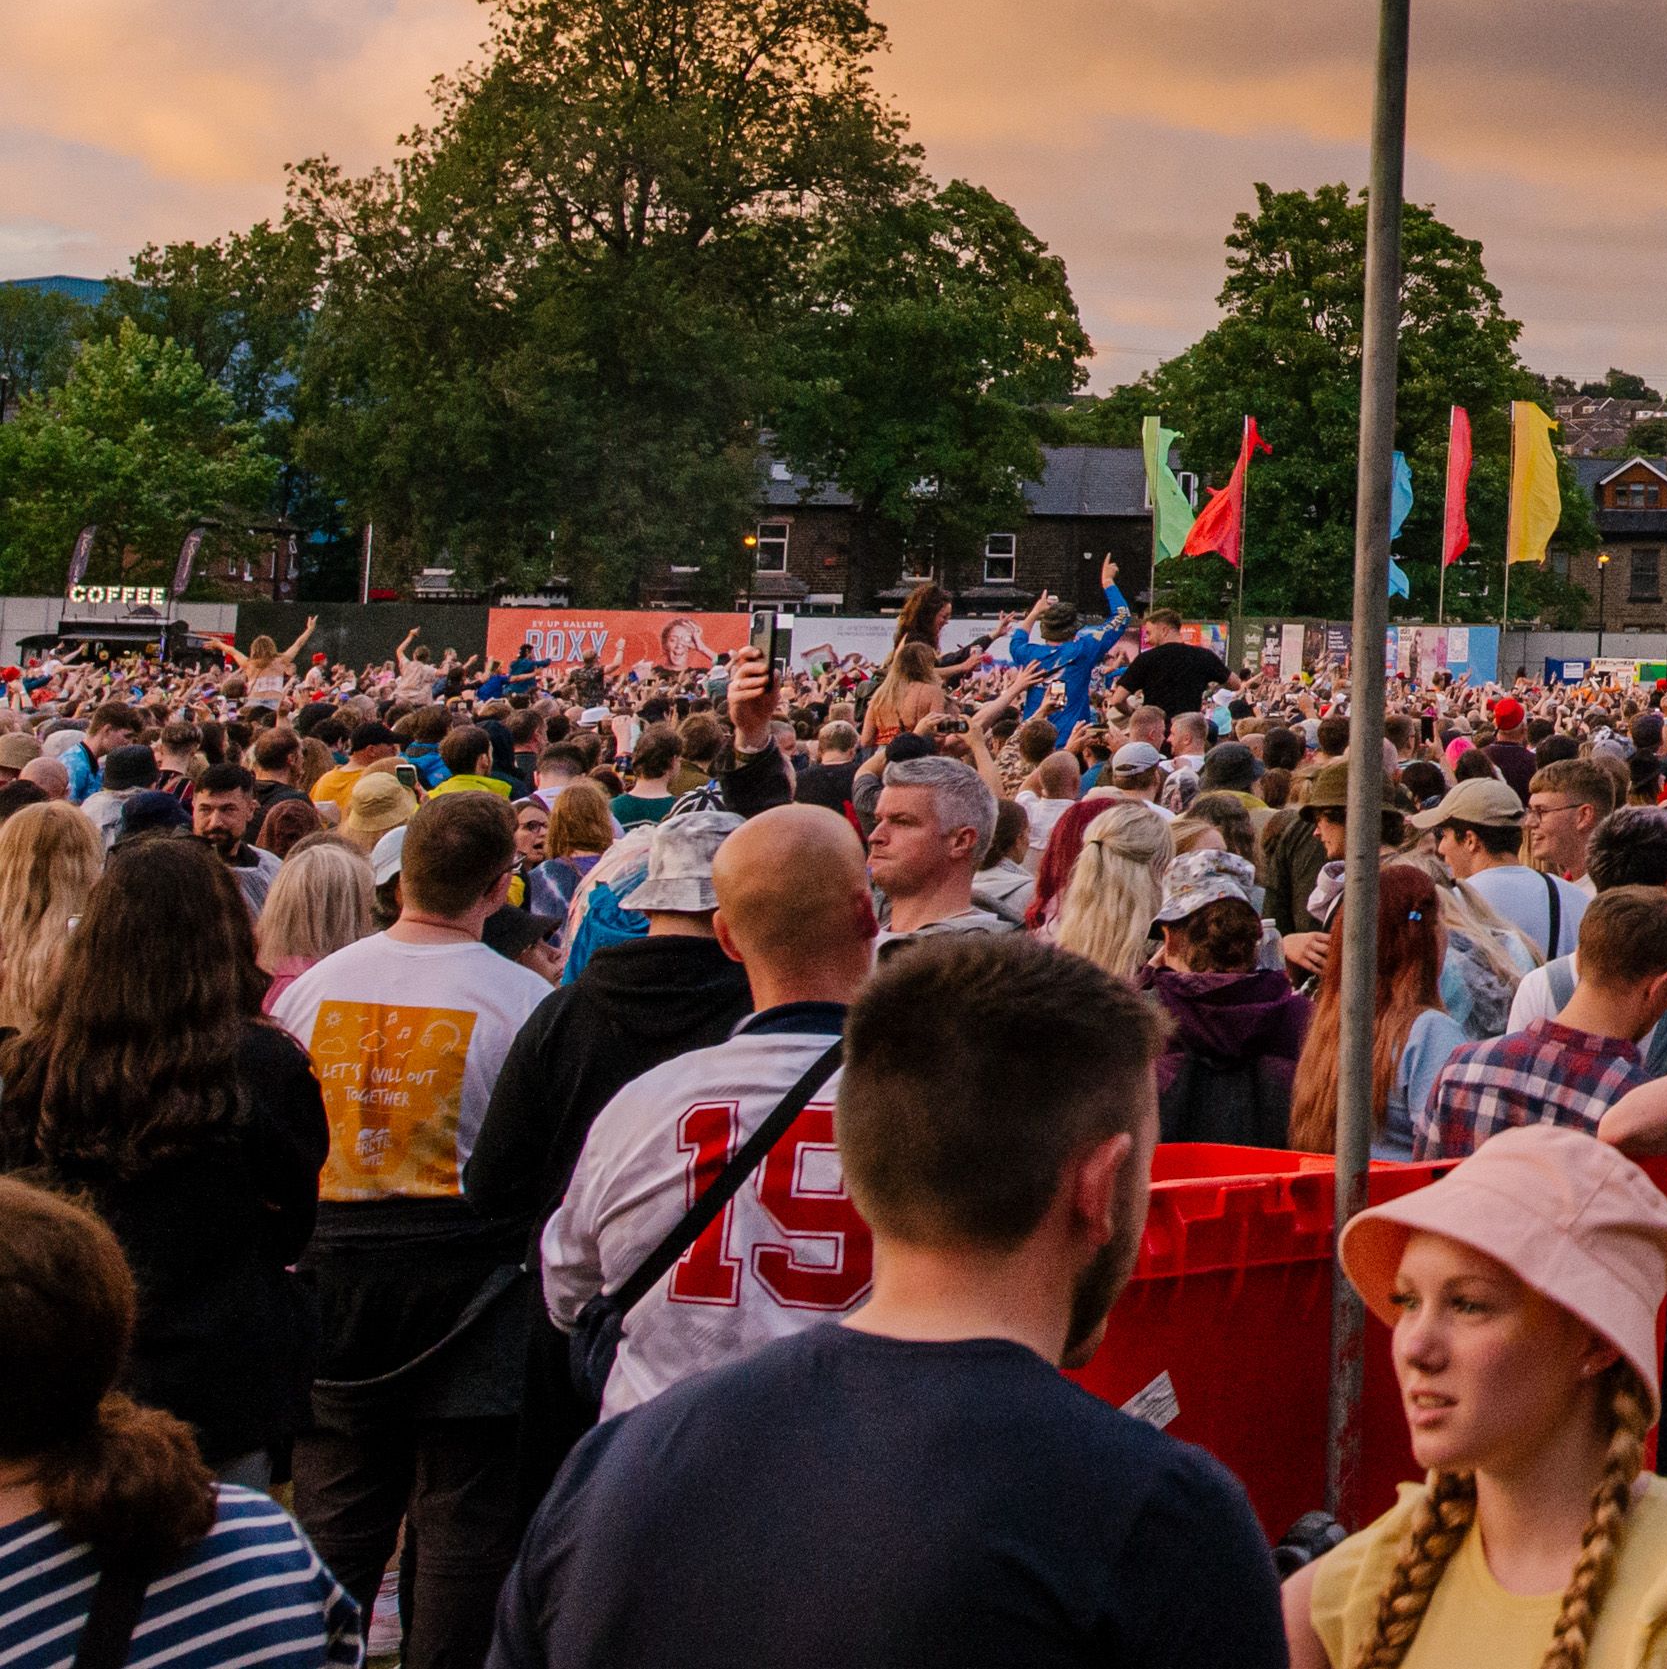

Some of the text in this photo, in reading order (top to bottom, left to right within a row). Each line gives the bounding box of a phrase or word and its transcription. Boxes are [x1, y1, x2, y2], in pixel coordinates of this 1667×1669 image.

[69, 585, 165, 605] COFFEE
[525, 629, 609, 663] ROXY
[322, 1062, 363, 1081] LET'S
[406, 1069, 439, 1086] OUT
[344, 1085, 410, 1108] TOGETHER
